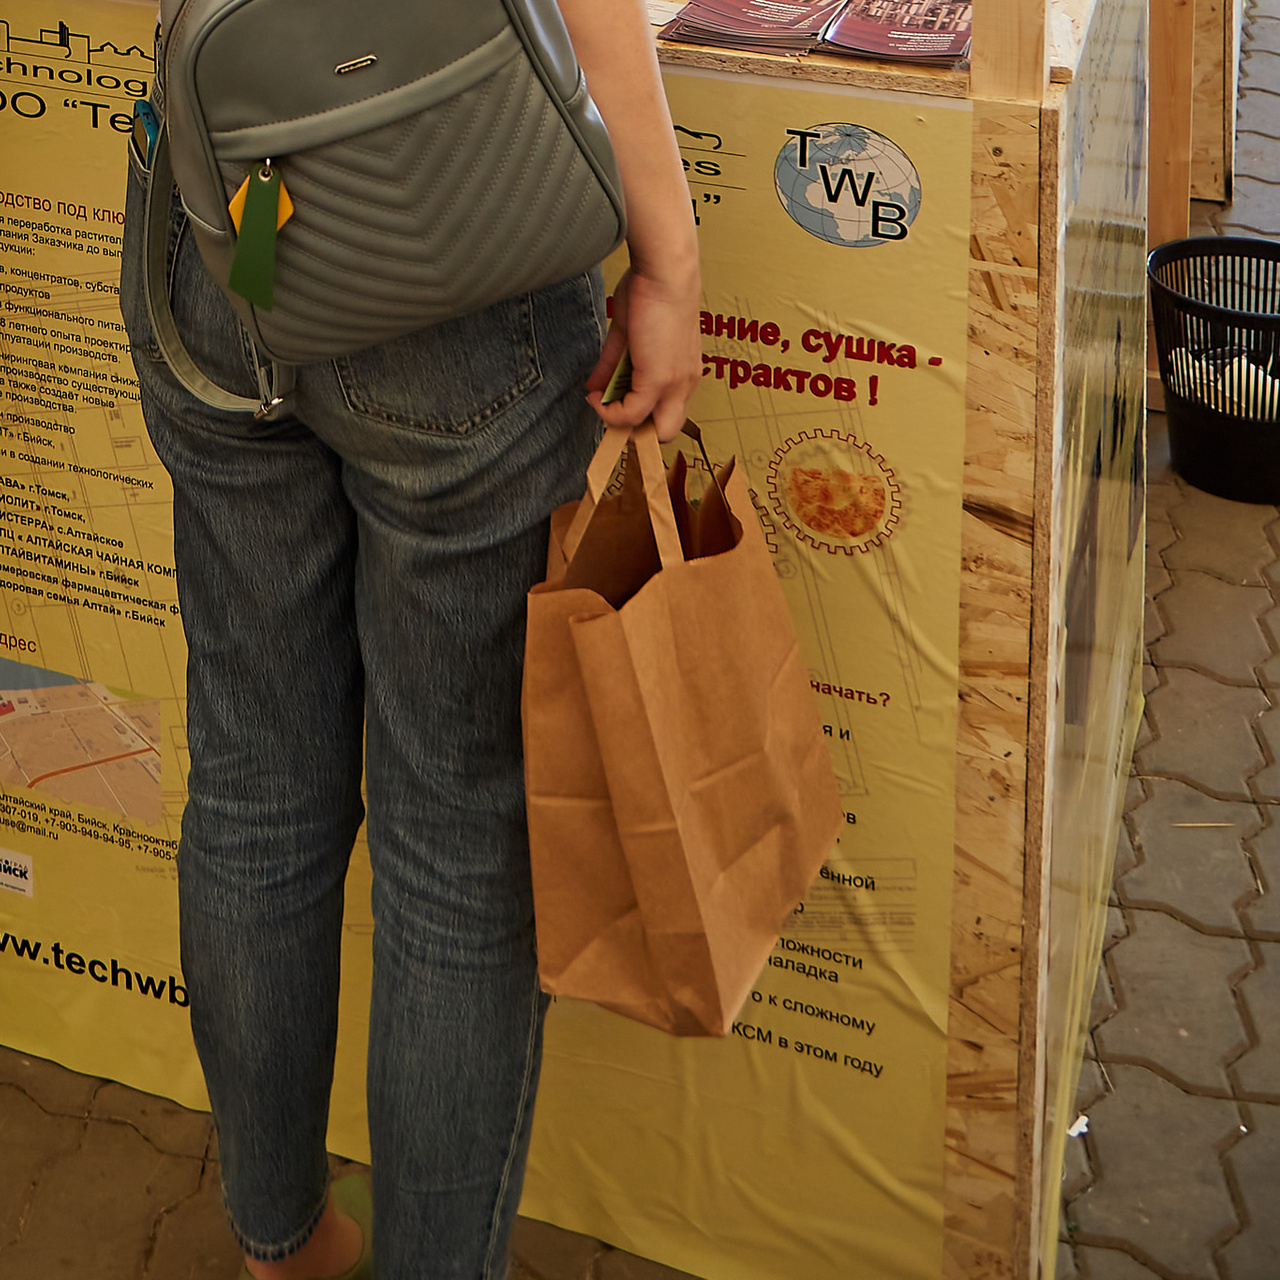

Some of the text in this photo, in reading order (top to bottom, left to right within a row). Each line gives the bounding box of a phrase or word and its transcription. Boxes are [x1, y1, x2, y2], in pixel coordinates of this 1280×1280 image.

[58, 201, 87, 221] под
[7, 216, 72, 236] переработка
[32, 233, 83, 252] Заказчика
[87, 245, 99, 255] до
[10, 268, 82, 289] концентратов,
[802, 329, 917, 368] сушка
[18, 432, 55, 449] г.Бийск,
[810, 680, 890, 707] начать?
[839, 728, 850, 740] и
[0, 805, 42, 824] 307-019,
[44, 816, 134, 851] +7-903-949-94-95,
[49, 807, 75, 821] край,
[78, 814, 110, 832] Бийск,
[769, 994, 777, 1006] к
[783, 998, 875, 1036] сложному
[732, 1021, 883, 1078] КСМ в этом году
